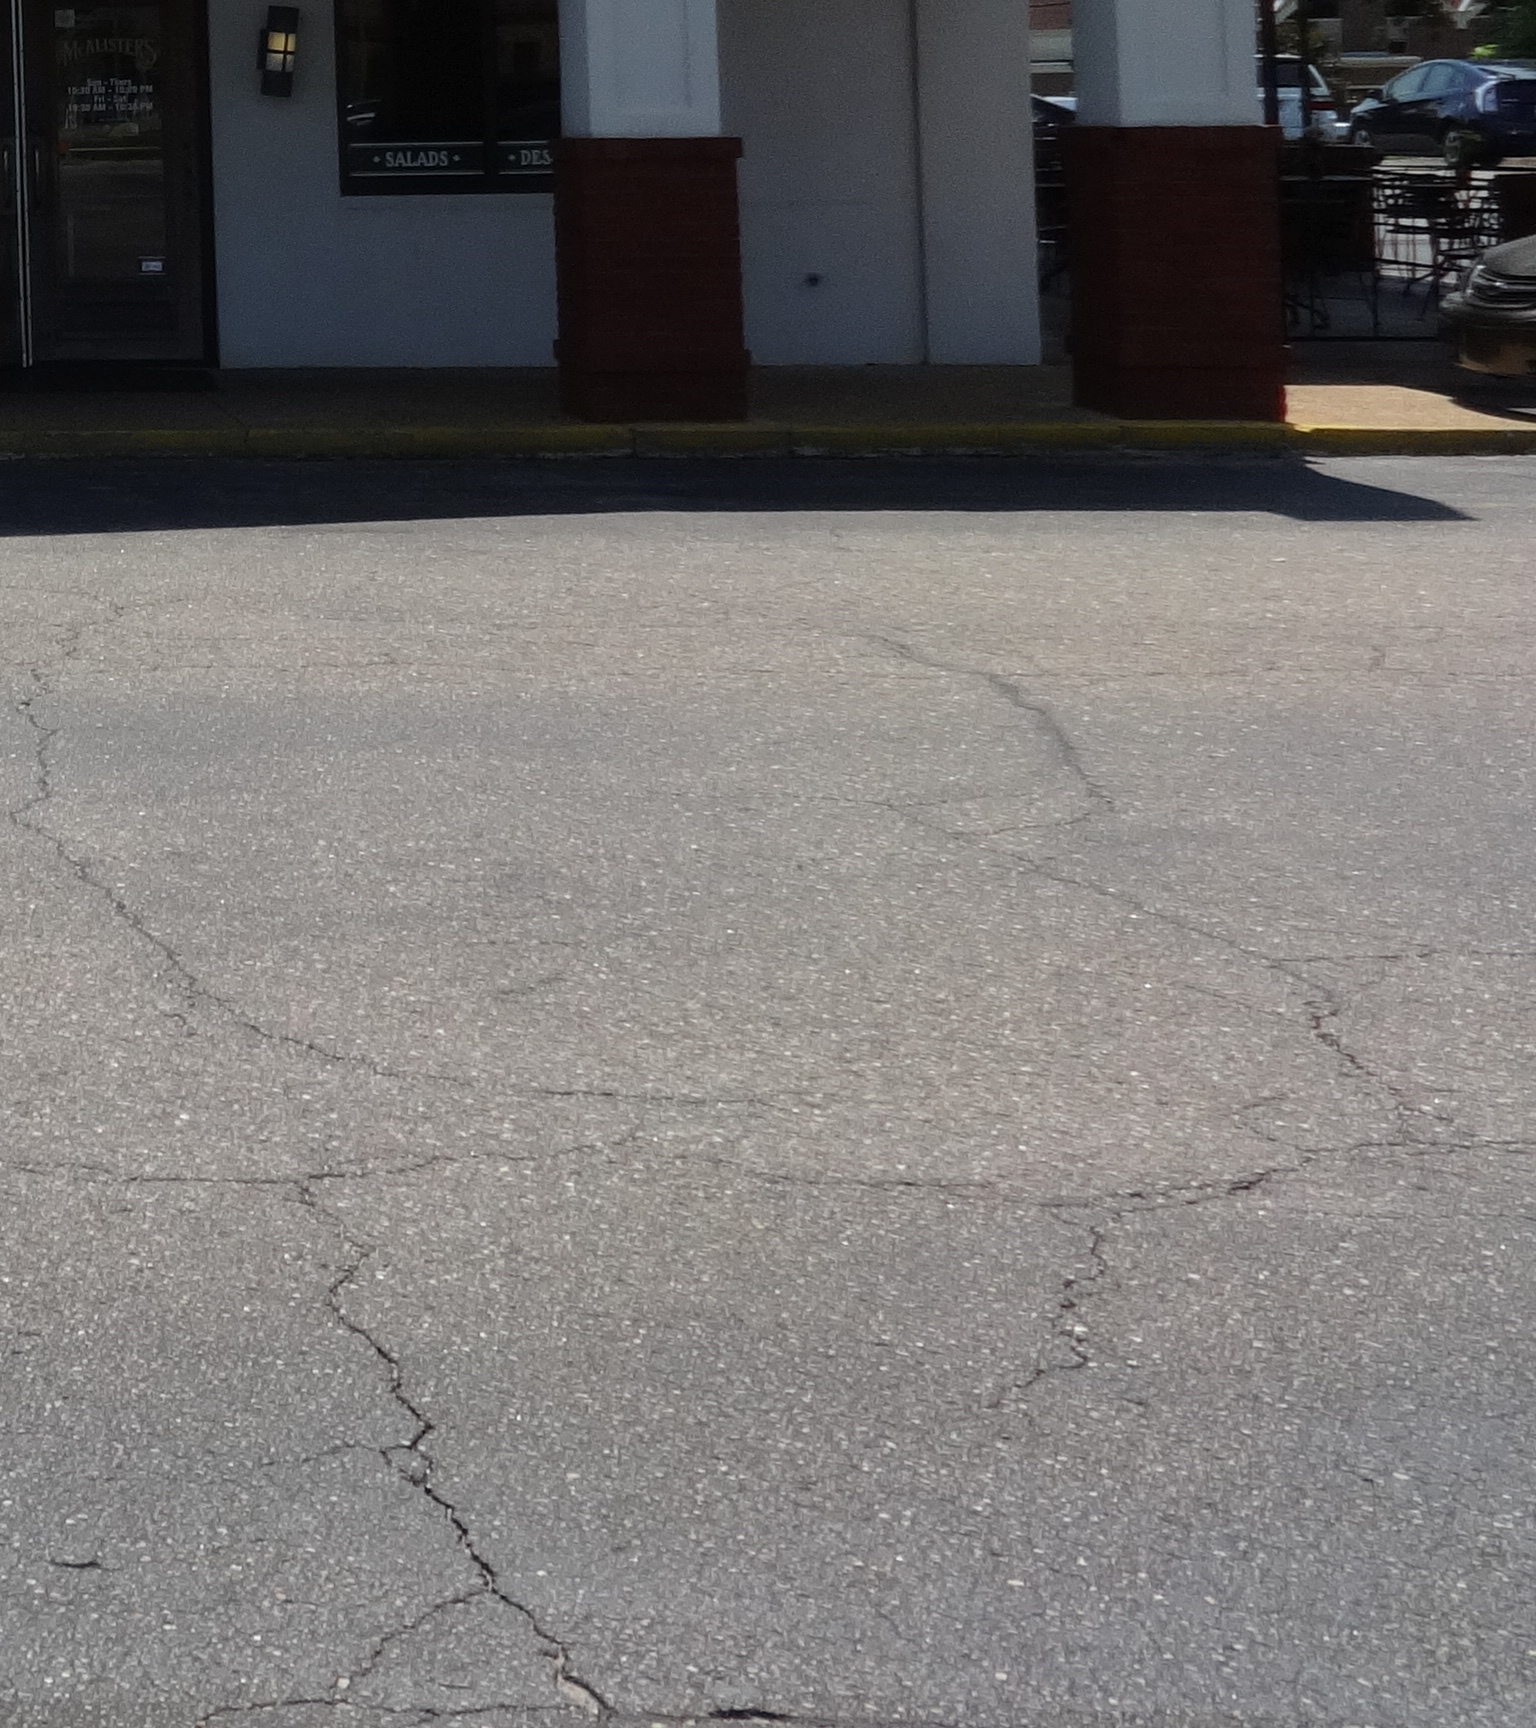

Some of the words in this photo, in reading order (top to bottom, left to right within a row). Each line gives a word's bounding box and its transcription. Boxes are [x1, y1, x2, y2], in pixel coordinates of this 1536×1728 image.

[58, 37, 157, 69] McALISTERS
[139, 84, 154, 94] PM
[384, 150, 450, 168] SALADS
[520, 149, 554, 166] DES
